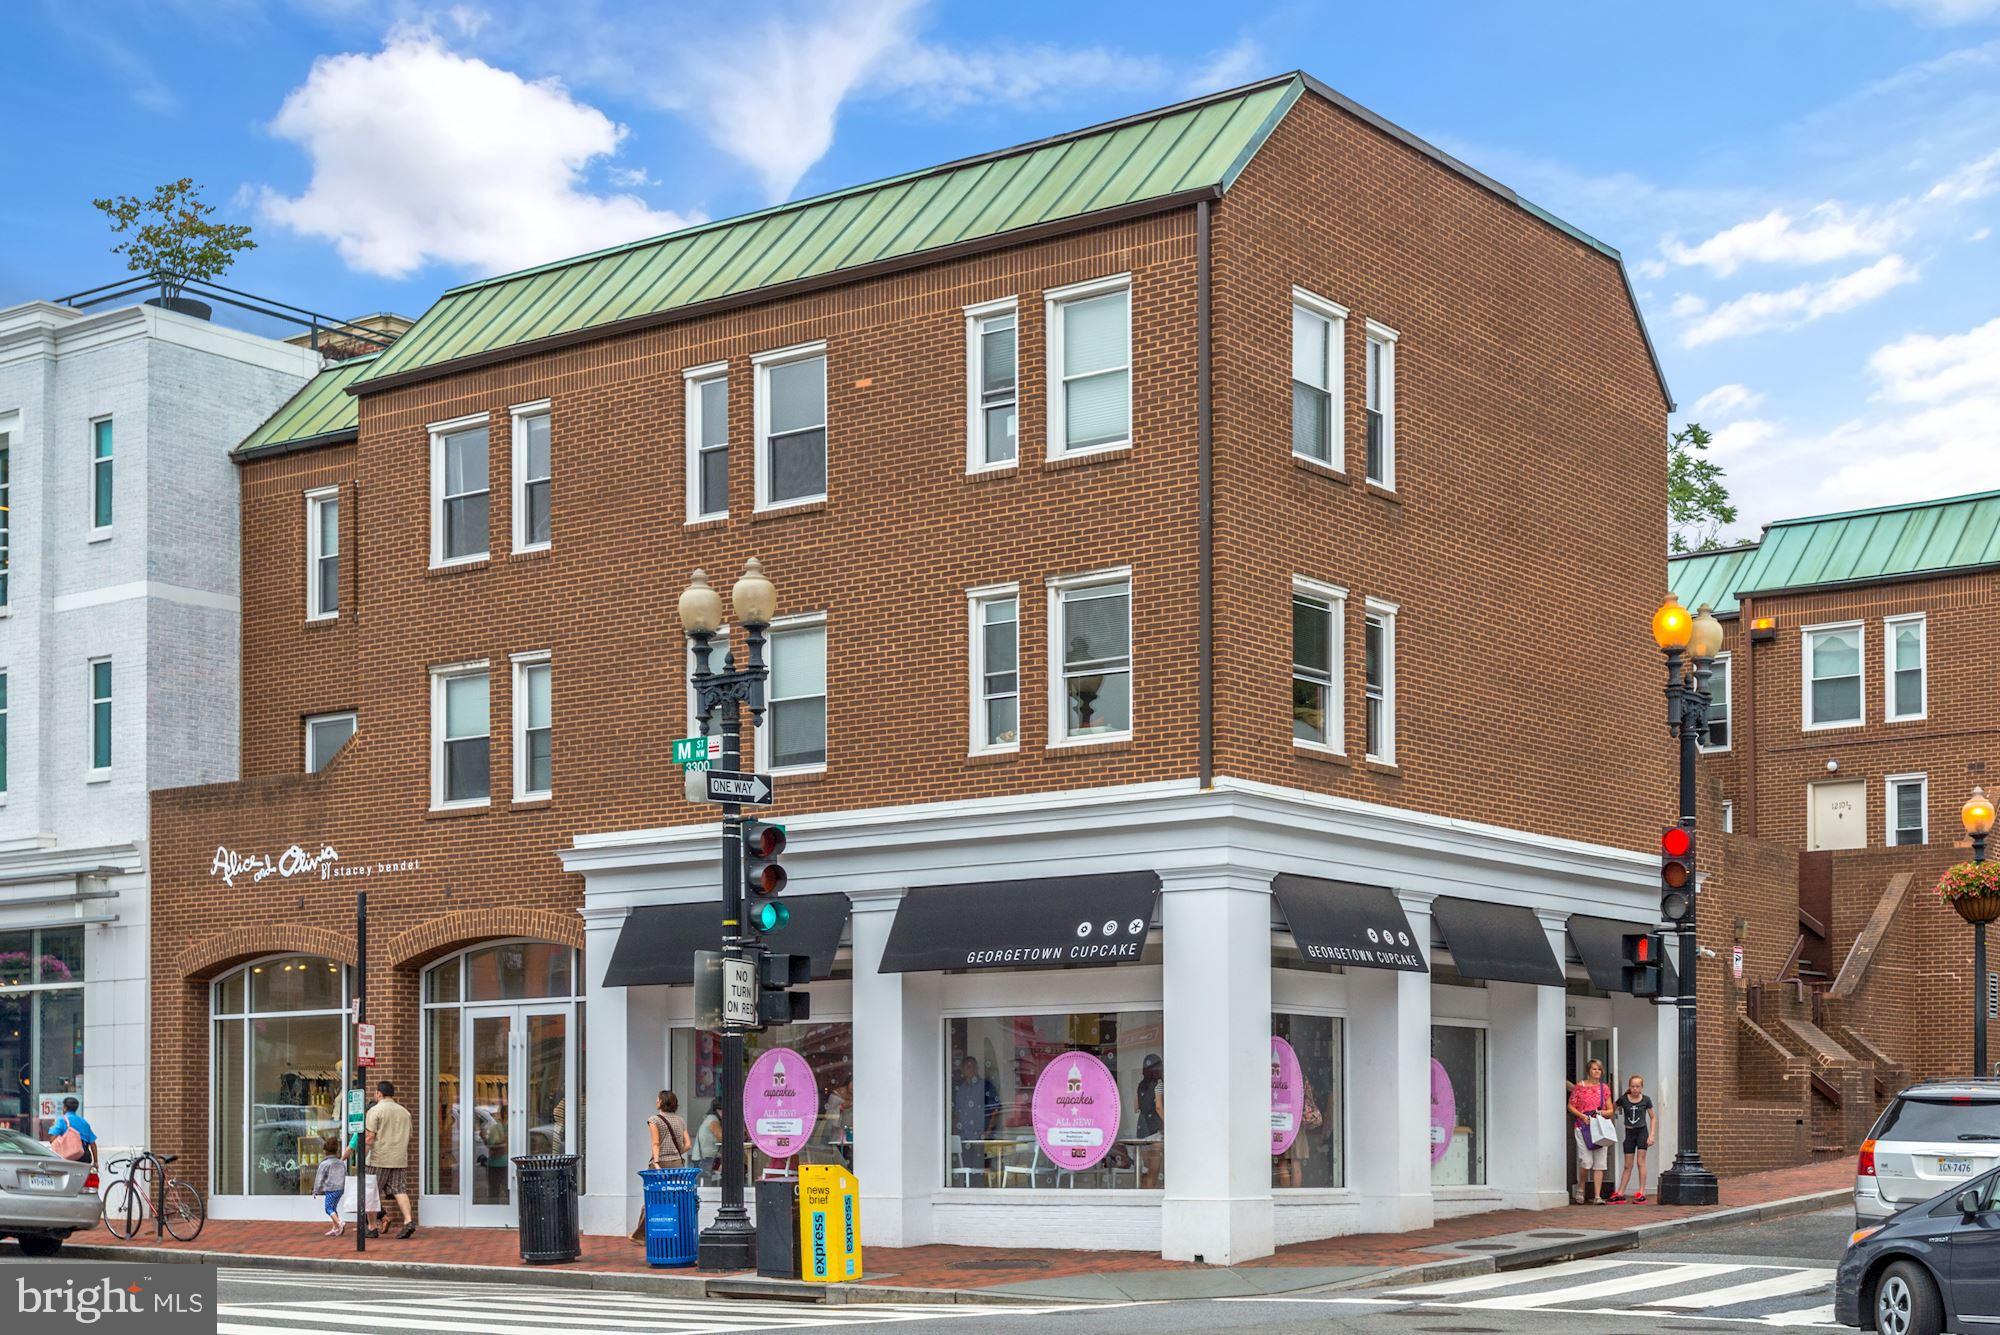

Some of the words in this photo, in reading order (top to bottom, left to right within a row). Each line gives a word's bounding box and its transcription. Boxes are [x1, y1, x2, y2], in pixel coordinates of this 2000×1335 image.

[678, 742, 691, 760] M
[696, 740, 704, 749] ST
[696, 749, 705, 758] NW
[686, 760, 710, 772] 3300
[713, 780, 732, 793] ONE
[734, 782, 753, 794] WAY
[210, 846, 263, 887] Alice
[254, 854, 277, 882] and
[278, 843, 339, 878] Olivia
[334, 865, 372, 877] stacey
[378, 859, 420, 874] bendet
[967, 947, 1062, 964] GEORGETOWN
[1070, 943, 1138, 959] CUPCAKE
[1307, 945, 1374, 962] GEORGETOWN
[1376, 951, 1419, 967] CUPCAKE
[736, 970, 748, 982] NO
[731, 984, 751, 998] TURN
[727, 1000, 738, 1013] ON
[742, 1002, 754, 1015] RED
[763, 1085, 797, 1100] cupcakes
[1056, 1092, 1095, 1108] cupcakes
[1056, 1118, 1071, 1126] ALL
[807, 1186, 830, 1195] news
[809, 1195, 829, 1205] brief
[845, 1197, 853, 1252] express
[815, 1214, 826, 1275] express
